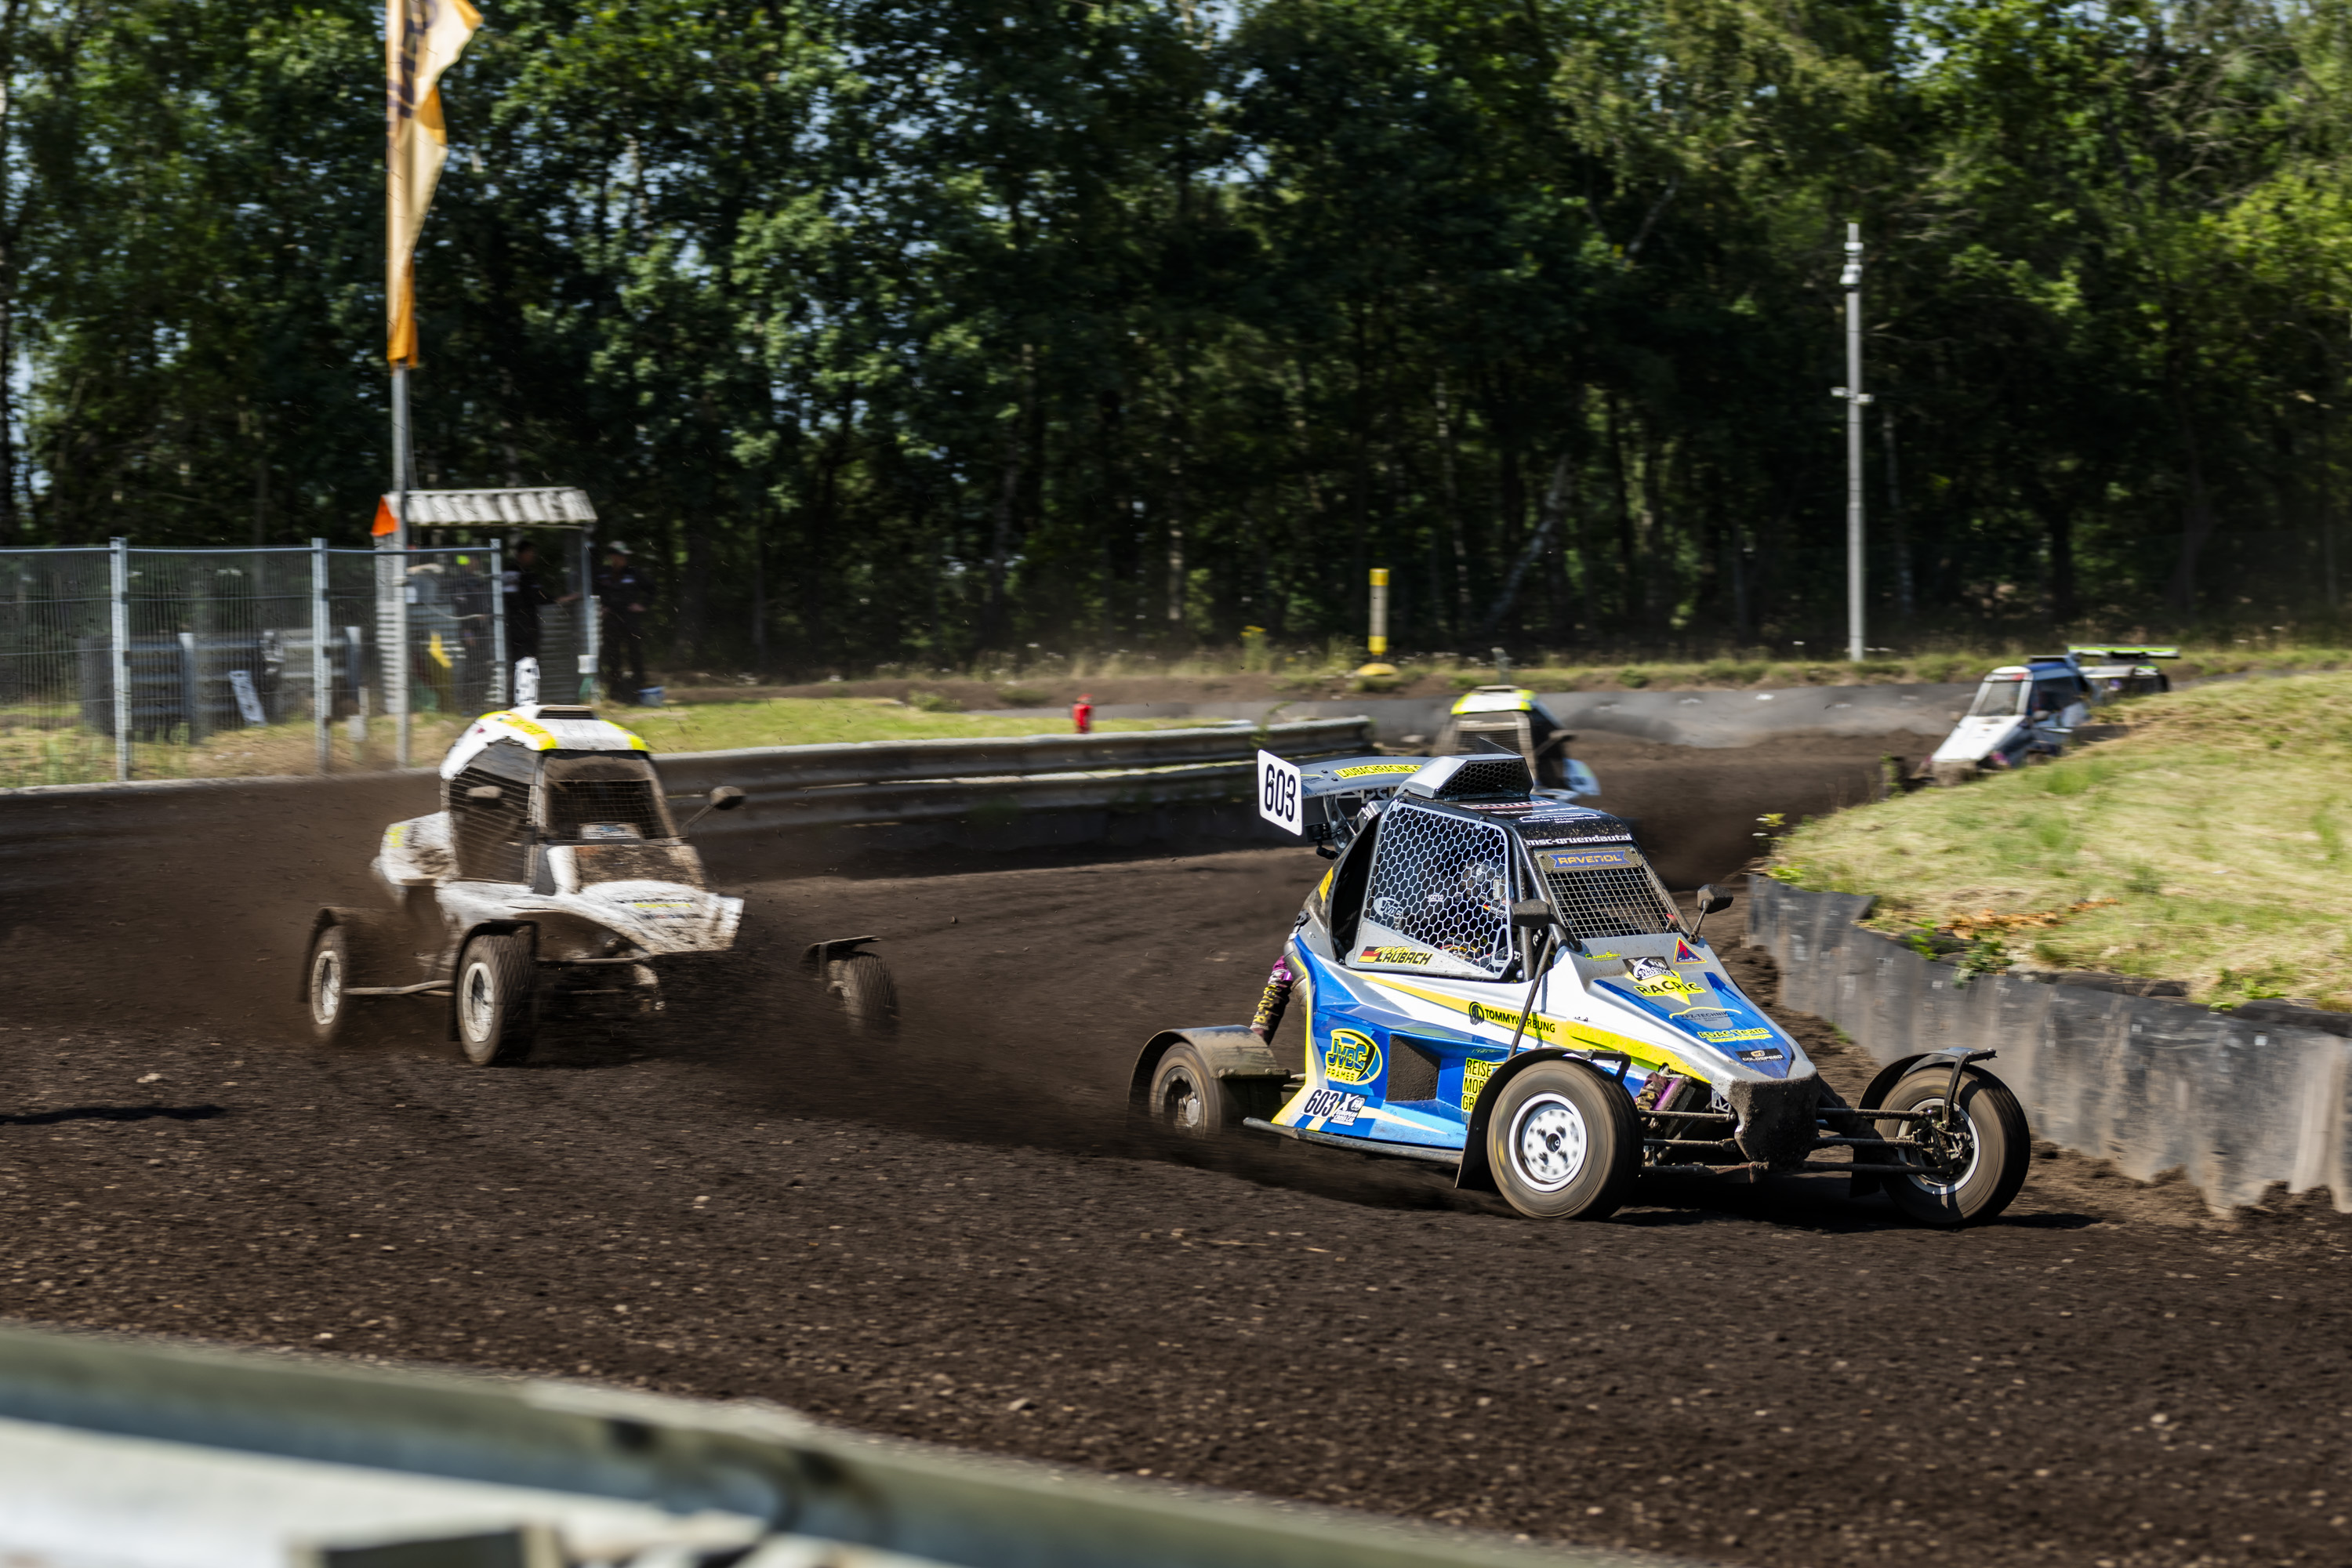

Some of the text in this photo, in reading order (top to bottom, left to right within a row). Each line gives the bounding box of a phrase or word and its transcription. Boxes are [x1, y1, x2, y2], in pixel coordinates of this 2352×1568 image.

[1265, 764, 1296, 822] 603
[1558, 854, 1622, 866] RAVENOL
[1374, 946, 1412, 954] STEVEN
[1376, 951, 1434, 965] LAUBACH
[1636, 981, 1701, 994] RACPIC
[1465, 1058, 1491, 1077] REISE
[1326, 1068, 1356, 1082] FRAMES
[1304, 1089, 1339, 1116] 603
